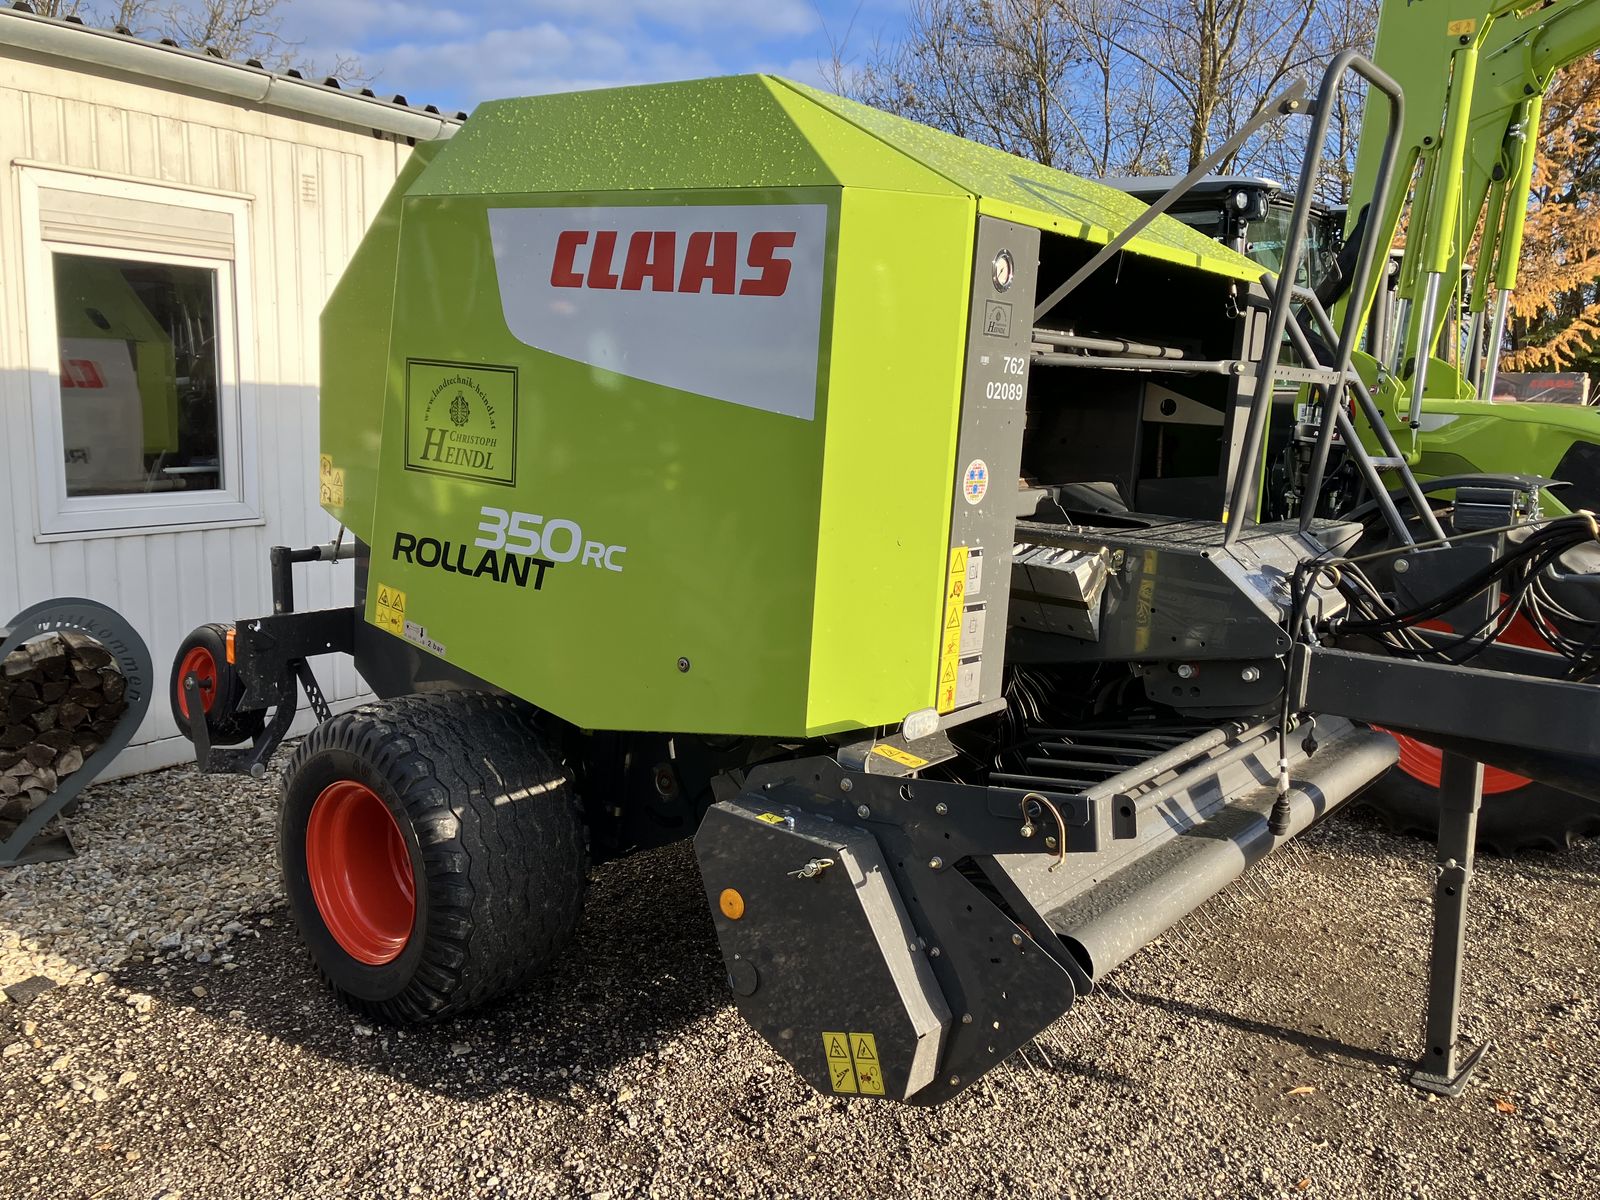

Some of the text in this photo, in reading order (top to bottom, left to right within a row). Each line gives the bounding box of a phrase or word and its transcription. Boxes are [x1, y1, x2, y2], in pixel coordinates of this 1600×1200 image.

[550, 230, 797, 297] CLAAS
[986, 381, 1023, 400] 02089
[1003, 356, 1025, 375] 762
[424, 373, 497, 430] www.landtechnik-heindl.at
[419, 426, 496, 470] HEINDL
[392, 531, 555, 591] ROLLANT
